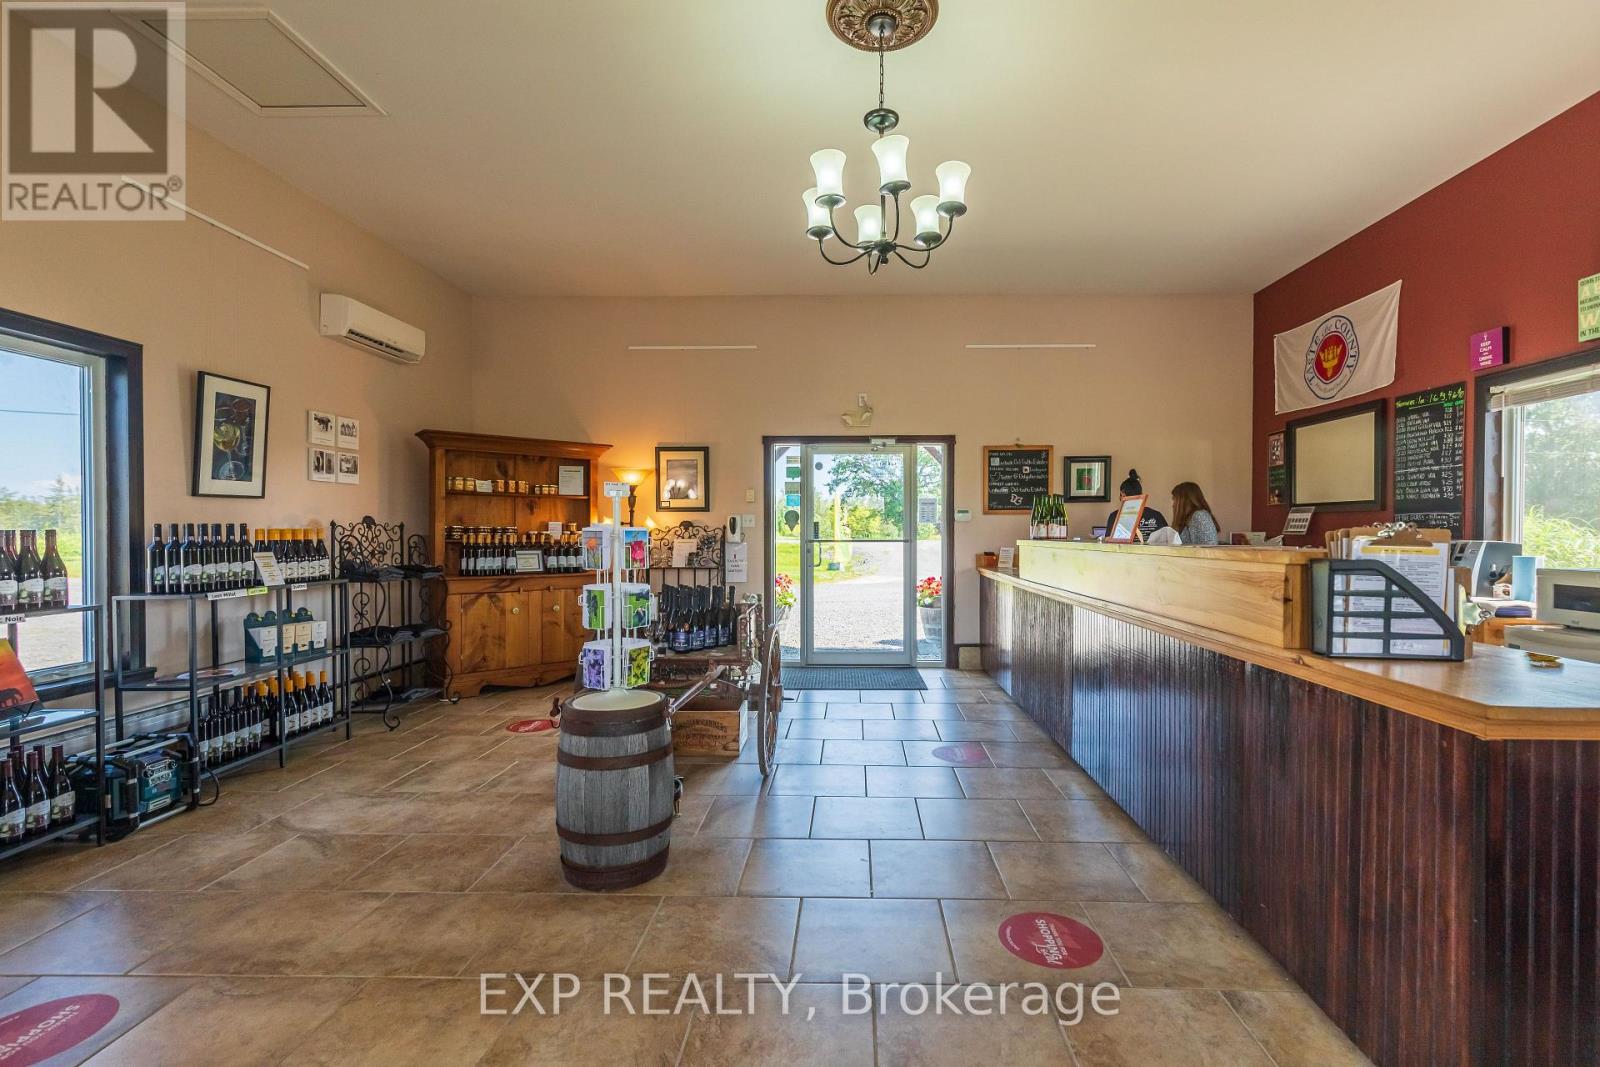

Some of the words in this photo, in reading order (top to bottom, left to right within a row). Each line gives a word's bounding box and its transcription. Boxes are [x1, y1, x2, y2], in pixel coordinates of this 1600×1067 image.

[1334, 319, 1358, 374] COUNTY
[1480, 345, 1492, 353] CALM
[1035, 919, 1063, 960] SHOPPING
